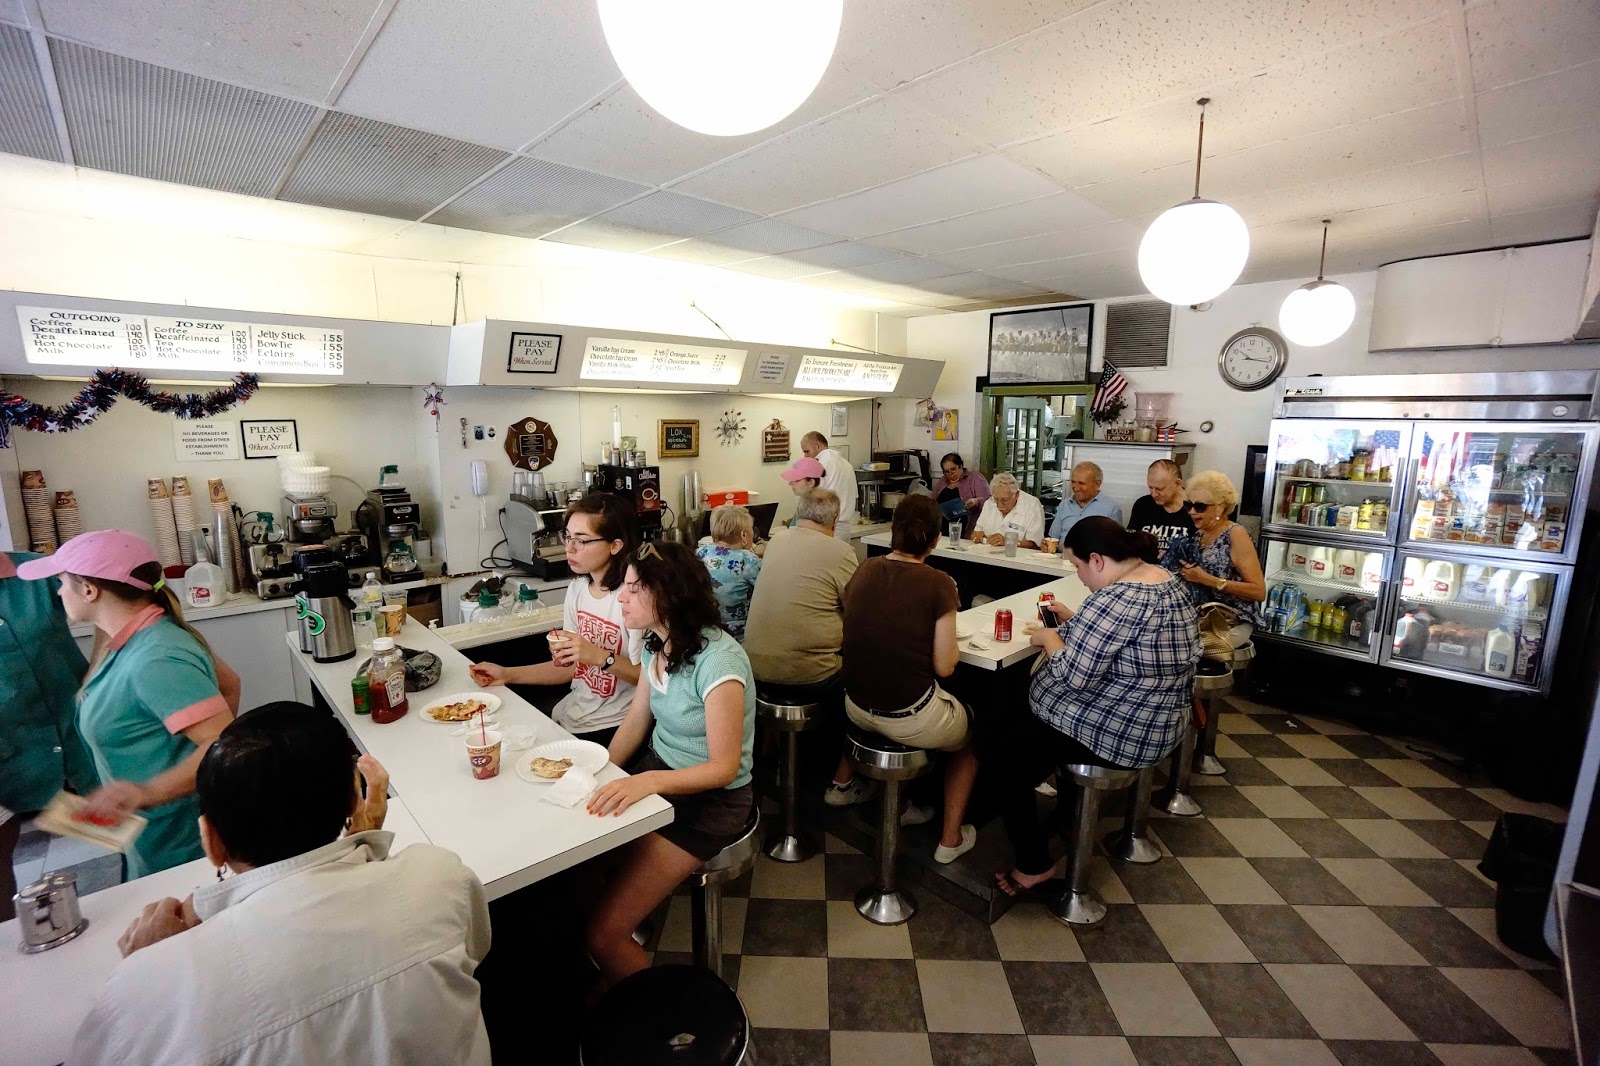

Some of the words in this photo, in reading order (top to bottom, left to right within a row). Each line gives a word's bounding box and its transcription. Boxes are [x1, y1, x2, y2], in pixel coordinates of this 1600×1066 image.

[50, 312, 121, 322] OUTGOING
[30, 318, 72, 326] Coffee
[31, 325, 115, 337] Decaffeinated
[258, 330, 279, 340] Jelly
[281, 332, 306, 340] Stick
[155, 333, 219, 342] Decaffeinated
[518, 339, 552, 348] PLEASE
[176, 347, 221, 355] Chocolate
[258, 349, 295, 358] Eclairs
